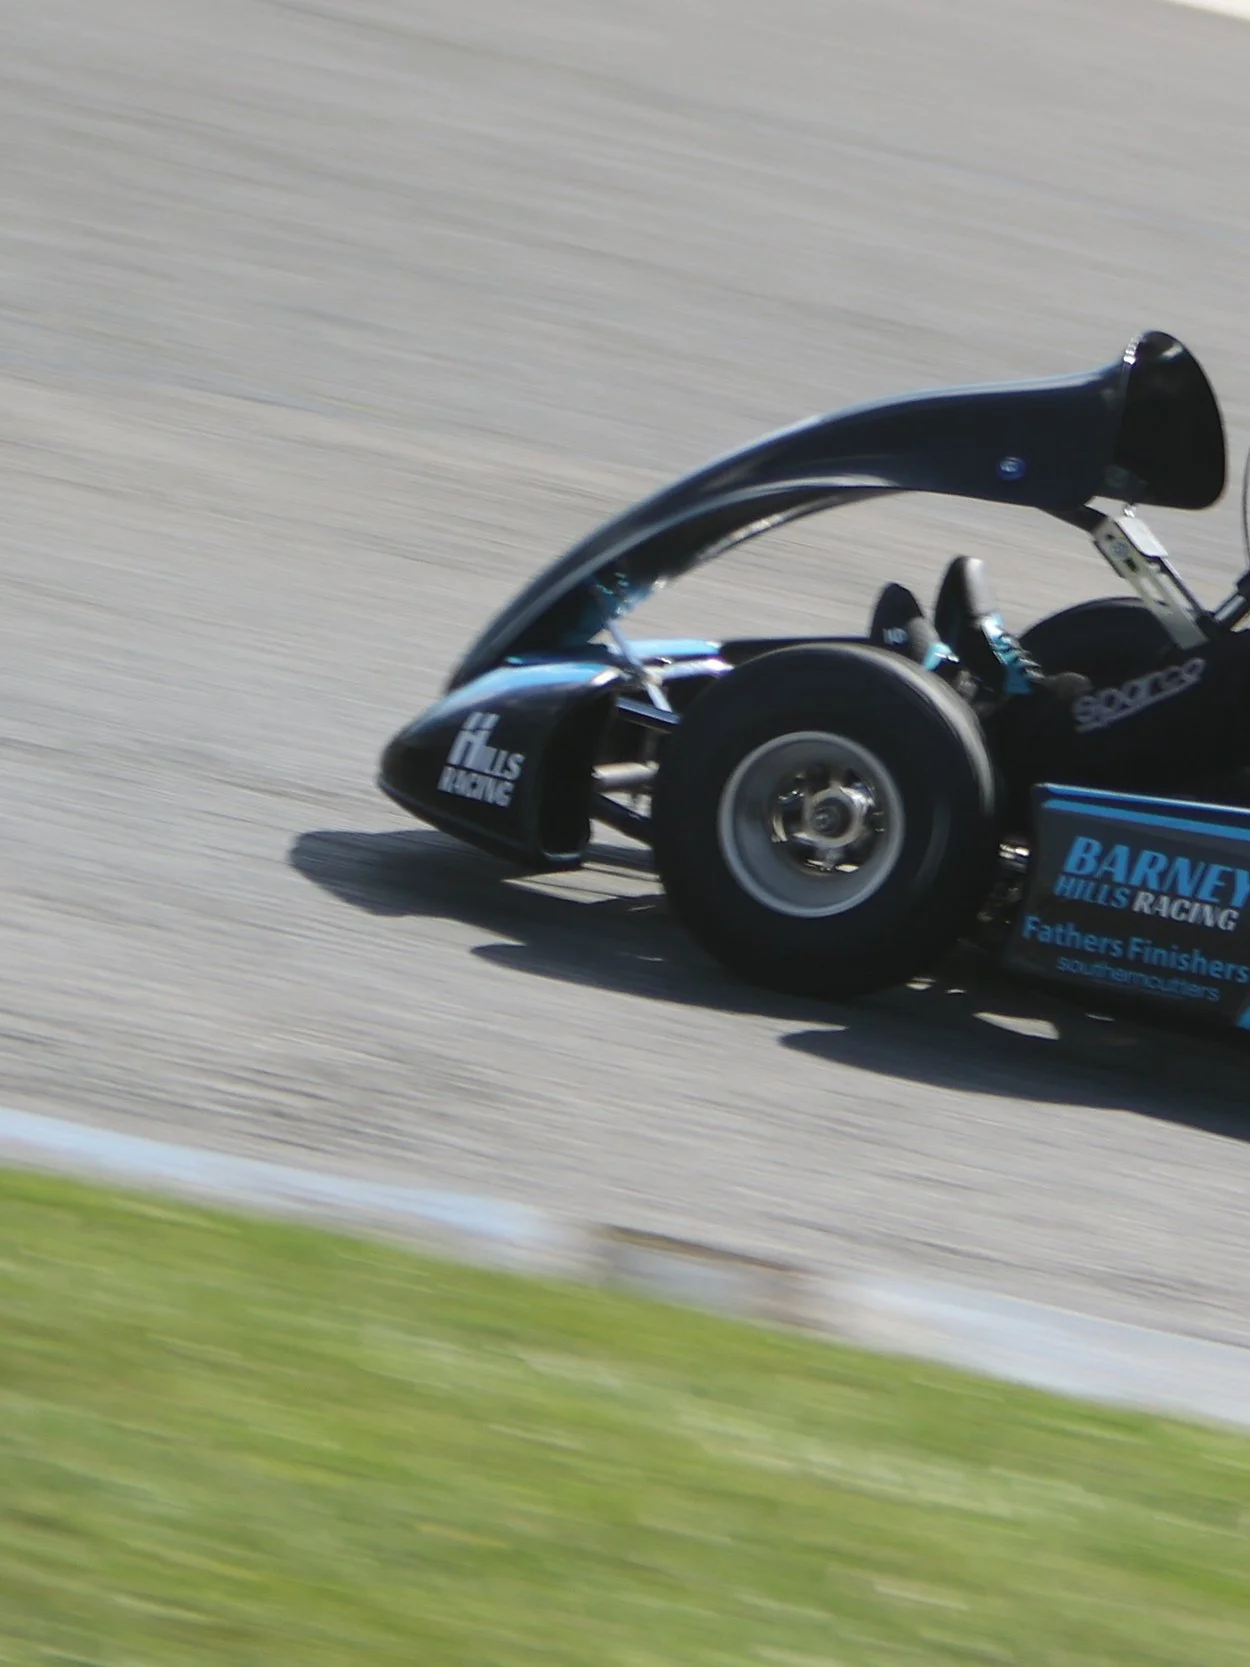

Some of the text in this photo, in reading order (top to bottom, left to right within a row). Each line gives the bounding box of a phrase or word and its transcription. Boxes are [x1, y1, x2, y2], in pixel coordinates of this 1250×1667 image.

[1053, 875, 1240, 932] HILLS RACING
[1021, 914, 1250, 984] Fathers Finishers
